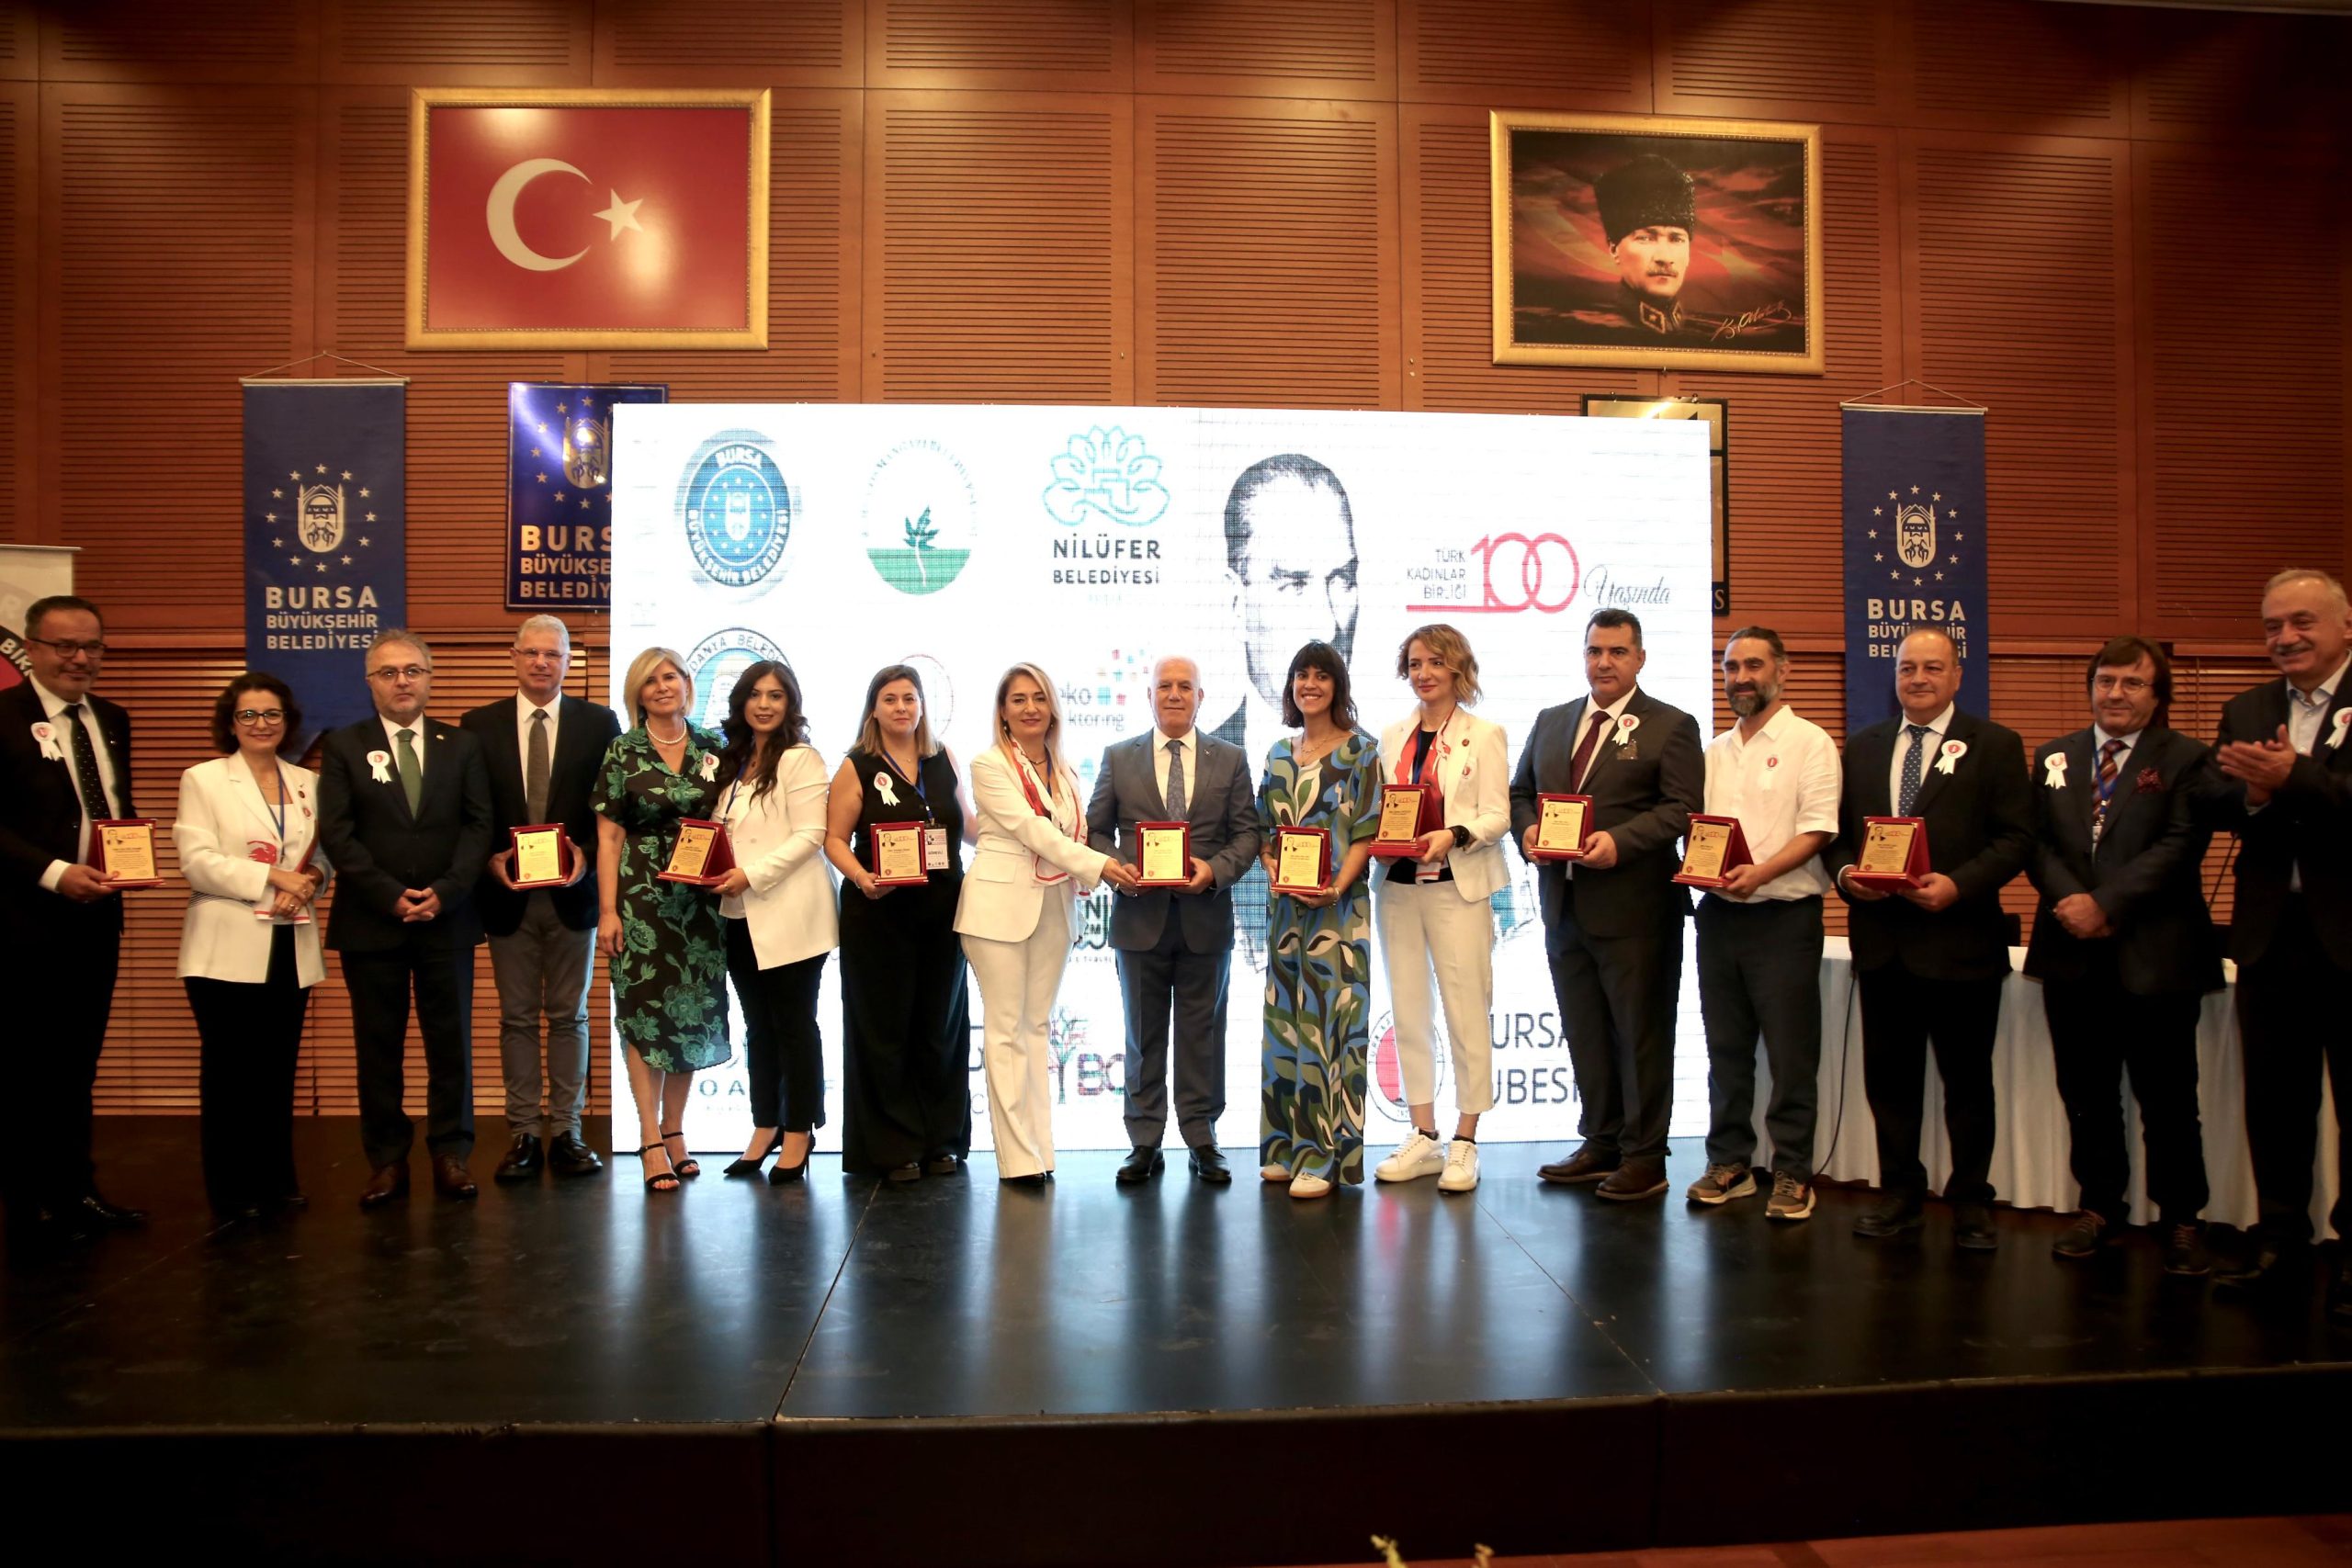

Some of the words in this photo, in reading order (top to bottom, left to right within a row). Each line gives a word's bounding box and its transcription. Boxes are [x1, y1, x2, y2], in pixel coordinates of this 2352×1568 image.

[1053, 533, 1161, 559] NİLÜFER
[1053, 566, 1160, 584] BELEDİYESİ
[1407, 568, 1465, 581] KADINLAR
[1470, 532, 1580, 614] 100
[266, 585, 379, 609] BURSA
[266, 609, 379, 631] BÜYÜKŞEHİR
[1867, 598, 1966, 621] BURSA
